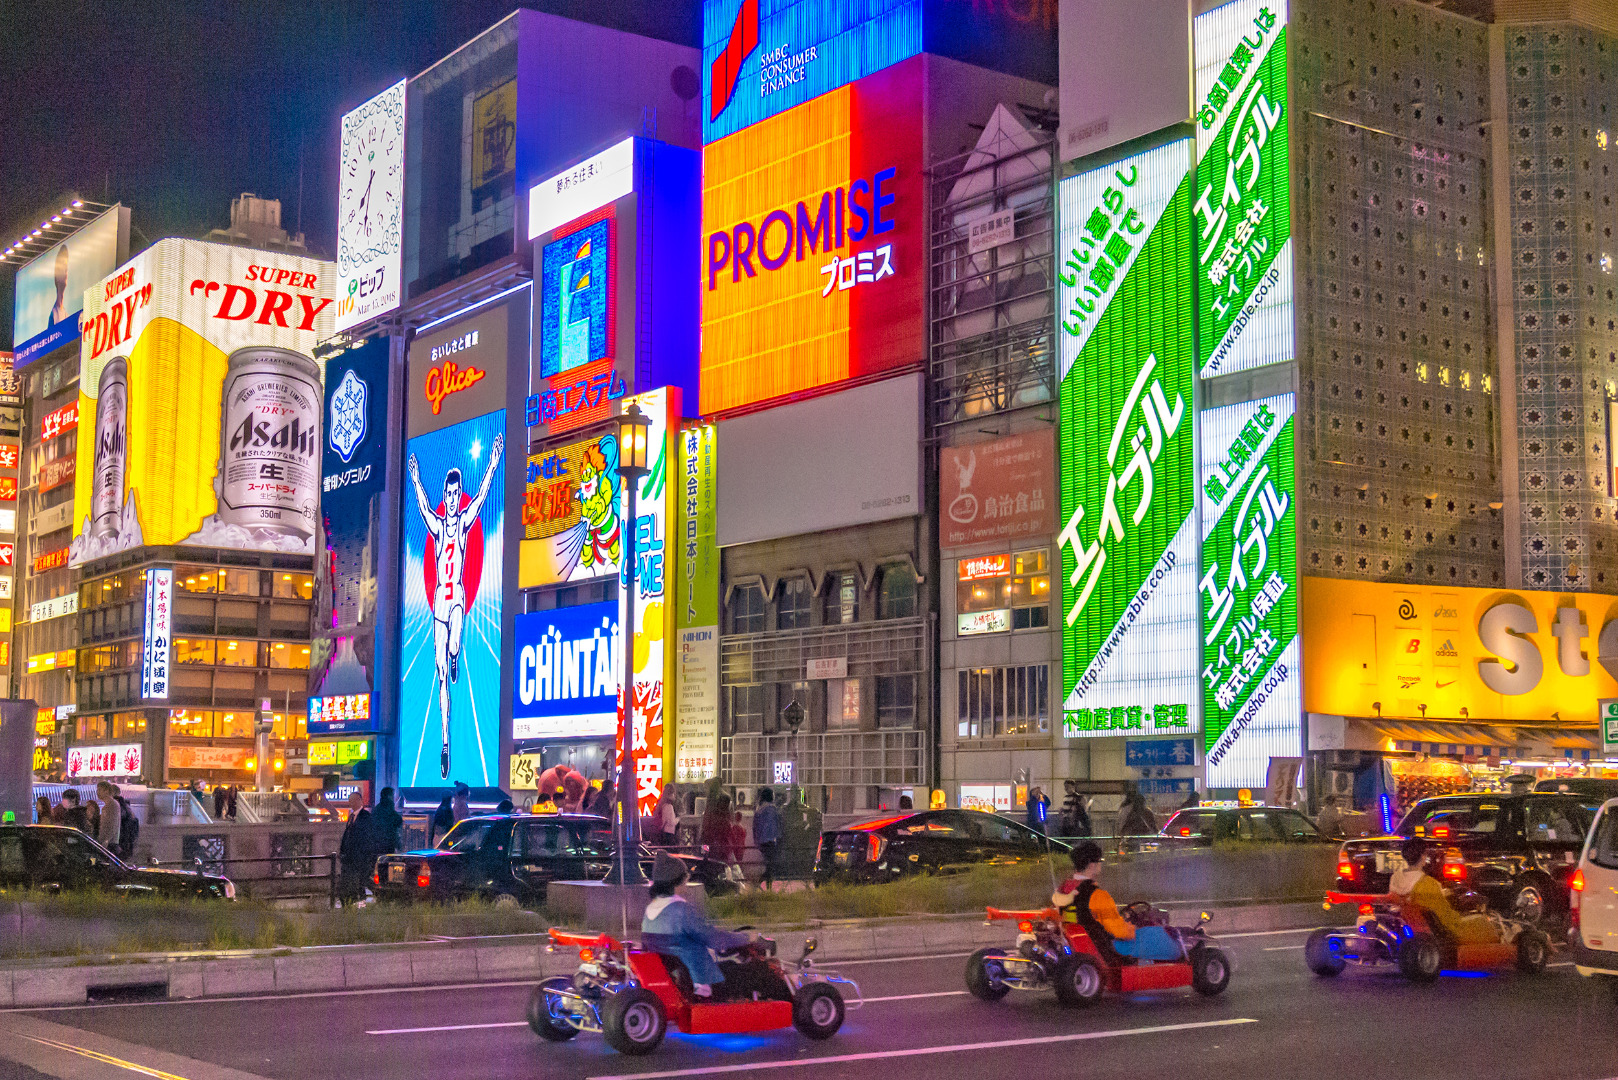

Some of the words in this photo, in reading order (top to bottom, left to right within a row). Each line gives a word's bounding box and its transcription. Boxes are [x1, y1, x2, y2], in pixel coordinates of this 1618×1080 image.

[760, 43, 790, 68] SMBC
[760, 46, 819, 84] CONSUMER
[1196, 6, 1277, 131] お部屋探しは
[760, 66, 806, 98] FINANCE
[1193, 80, 1283, 262] エイブル
[708, 166, 896, 291] PROMISE
[1058, 164, 1138, 288] いい暮らし
[1207, 198, 1270, 287] 株式会社
[104, 267, 135, 303] SUPER
[245, 264, 318, 290] SUPER
[359, 265, 386, 299] ピップ
[820, 244, 895, 297] プロミス
[1062, 207, 1146, 338] いい部屋で
[1210, 236, 1268, 322] エイブル
[1208, 267, 1280, 372] www.able.co.jp
[431, 331, 479, 362] おいしさと健康
[241, 388, 256, 403] ASAHI
[257, 383, 289, 394] BREWERIES
[289, 390, 306, 410] LIMITED
[425, 361, 486, 416] Glico
[524, 369, 626, 428] 日商エステム
[229, 411, 316, 458] Asahi
[1203, 403, 1277, 506] 借上保証は
[248, 484, 297, 496] スーパードライ
[260, 464, 284, 481] 生
[323, 464, 372, 492] 雪印メグミルク
[526, 457, 569, 484] かぜに
[1056, 358, 1185, 608] エイブル
[260, 509, 282, 520] 350ml
[522, 480, 572, 526] 改源
[983, 489, 1045, 520] 鳥治食品
[686, 436, 699, 623] 株式会社日本リート
[1198, 465, 1291, 640] エイブル
[444, 539, 456, 601] グリコ
[156, 589, 168, 632] 本場の味
[1074, 549, 1177, 700] http://www.able.co.jp
[1201, 570, 1289, 691] エイブル保証
[1434, 604, 1458, 618] asics
[683, 631, 712, 642] NIHON
[153, 635, 168, 695] かに道楽
[1214, 628, 1279, 713] 株式会社
[1063, 703, 1189, 733] 不動産賃貸・管理
[1208, 662, 1289, 769] www.a-hosho.co.jp
[679, 757, 714, 768] 広告主募集中
[774, 762, 792, 778] BAR
